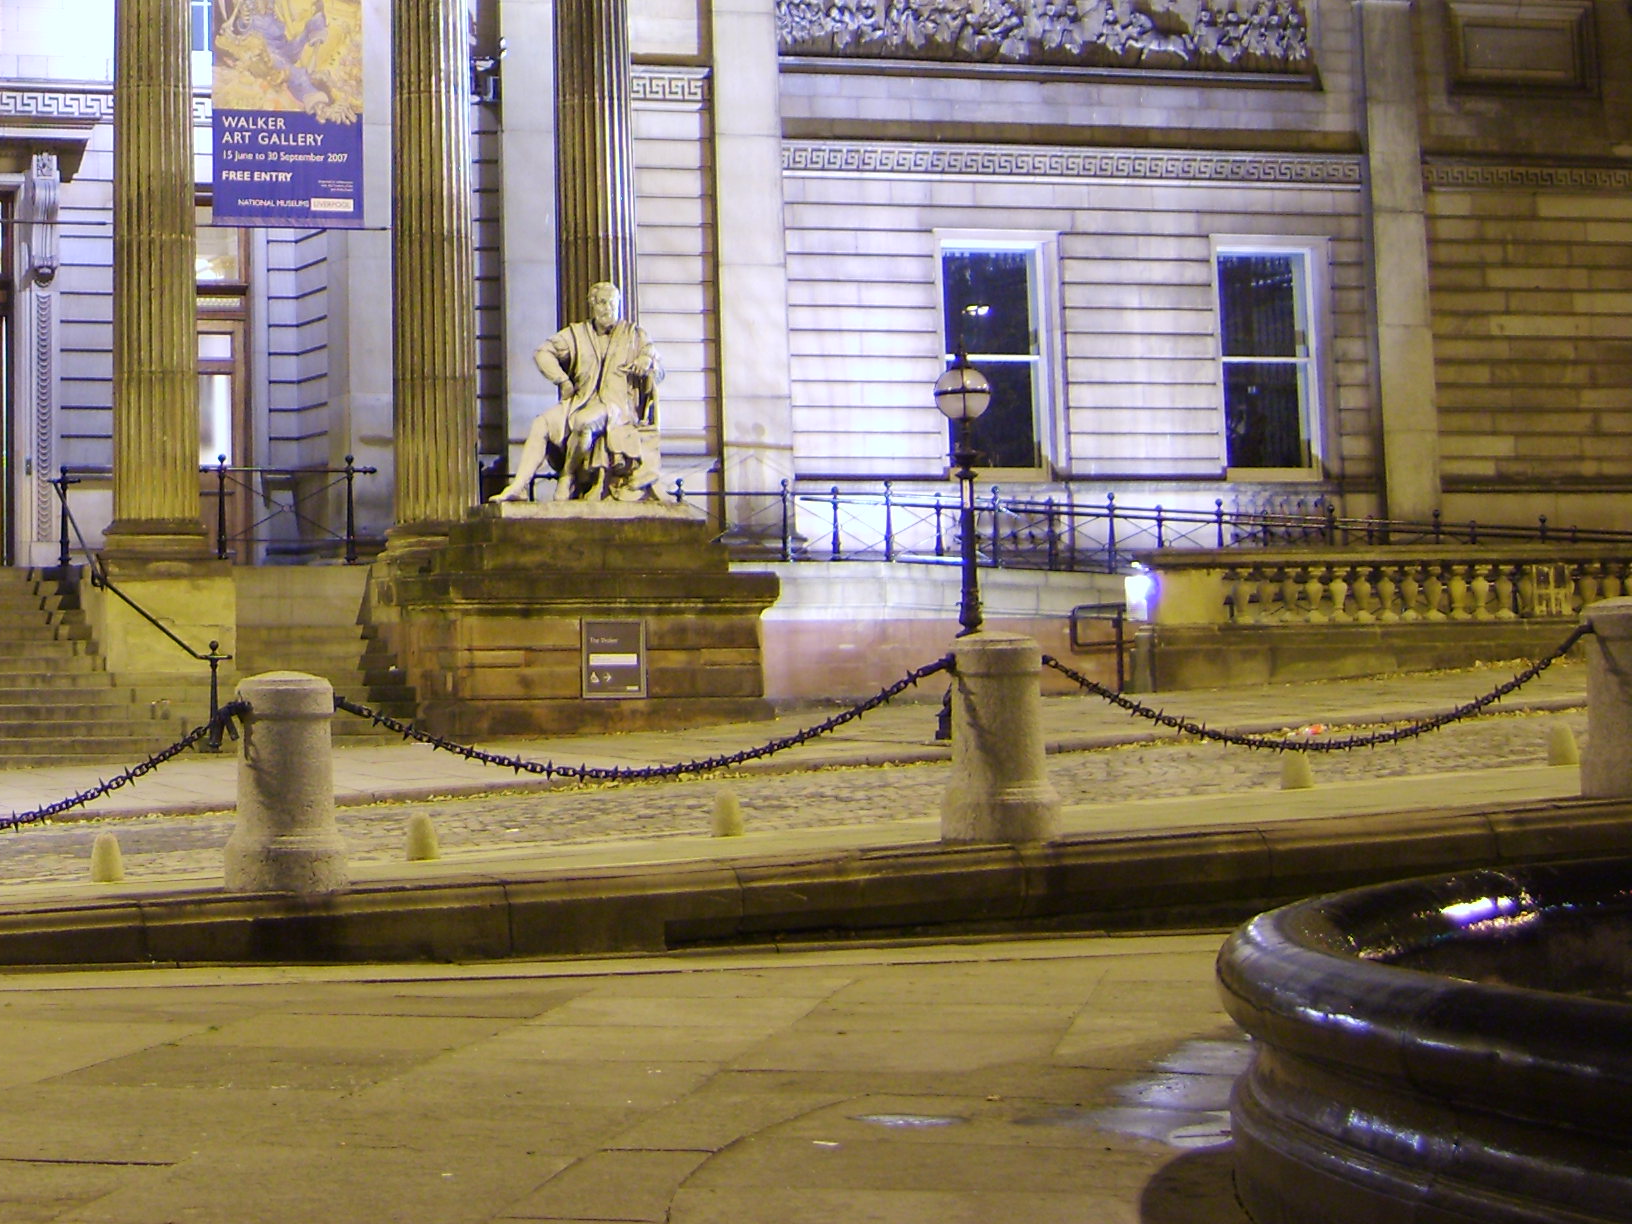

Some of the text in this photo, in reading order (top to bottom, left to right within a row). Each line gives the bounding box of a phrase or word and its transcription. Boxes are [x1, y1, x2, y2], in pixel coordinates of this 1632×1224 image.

[222, 116, 286, 130] WALKER
[222, 132, 324, 146] ART GALLERY
[223, 150, 348, 164] 15 June to 30 September 2007
[222, 170, 293, 182] FREE ENTRY
